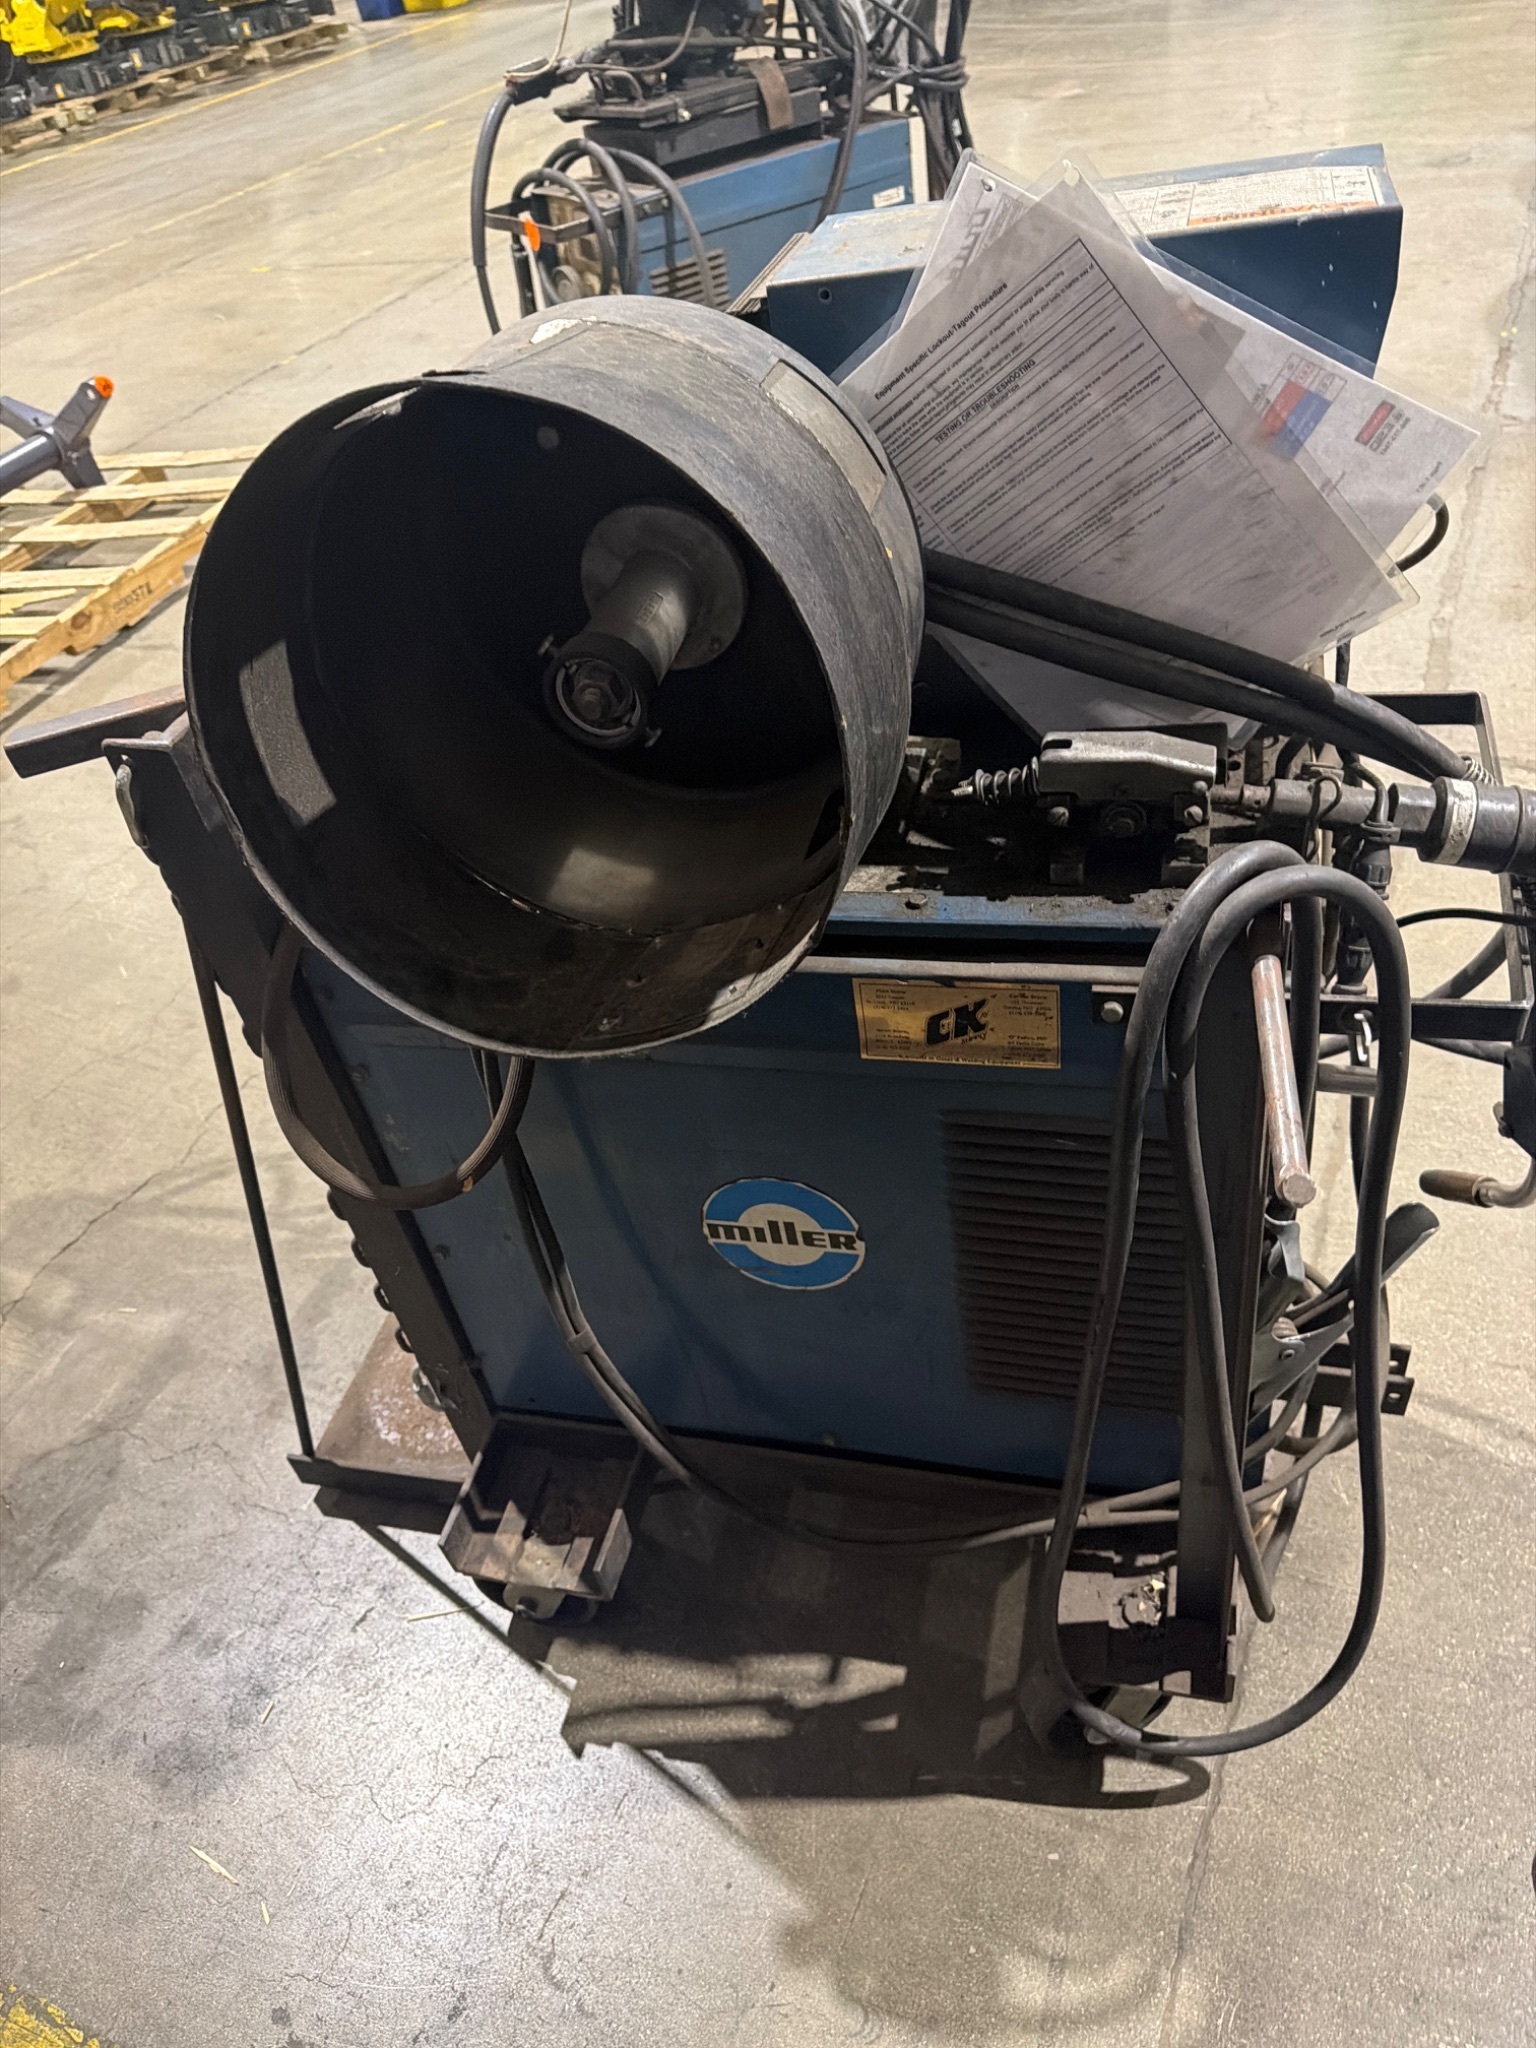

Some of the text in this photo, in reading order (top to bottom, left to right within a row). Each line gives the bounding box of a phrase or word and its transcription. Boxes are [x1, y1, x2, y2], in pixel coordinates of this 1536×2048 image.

[873, 371, 907, 401] Equipment
[903, 350, 930, 375] Specific
[926, 310, 976, 354] Lockout-Tagout
[972, 281, 1009, 313] Procedure
[934, 418, 962, 444] TESTING
[959, 409, 973, 423] OR
[970, 357, 1036, 414] TROUBLESHOOTING
